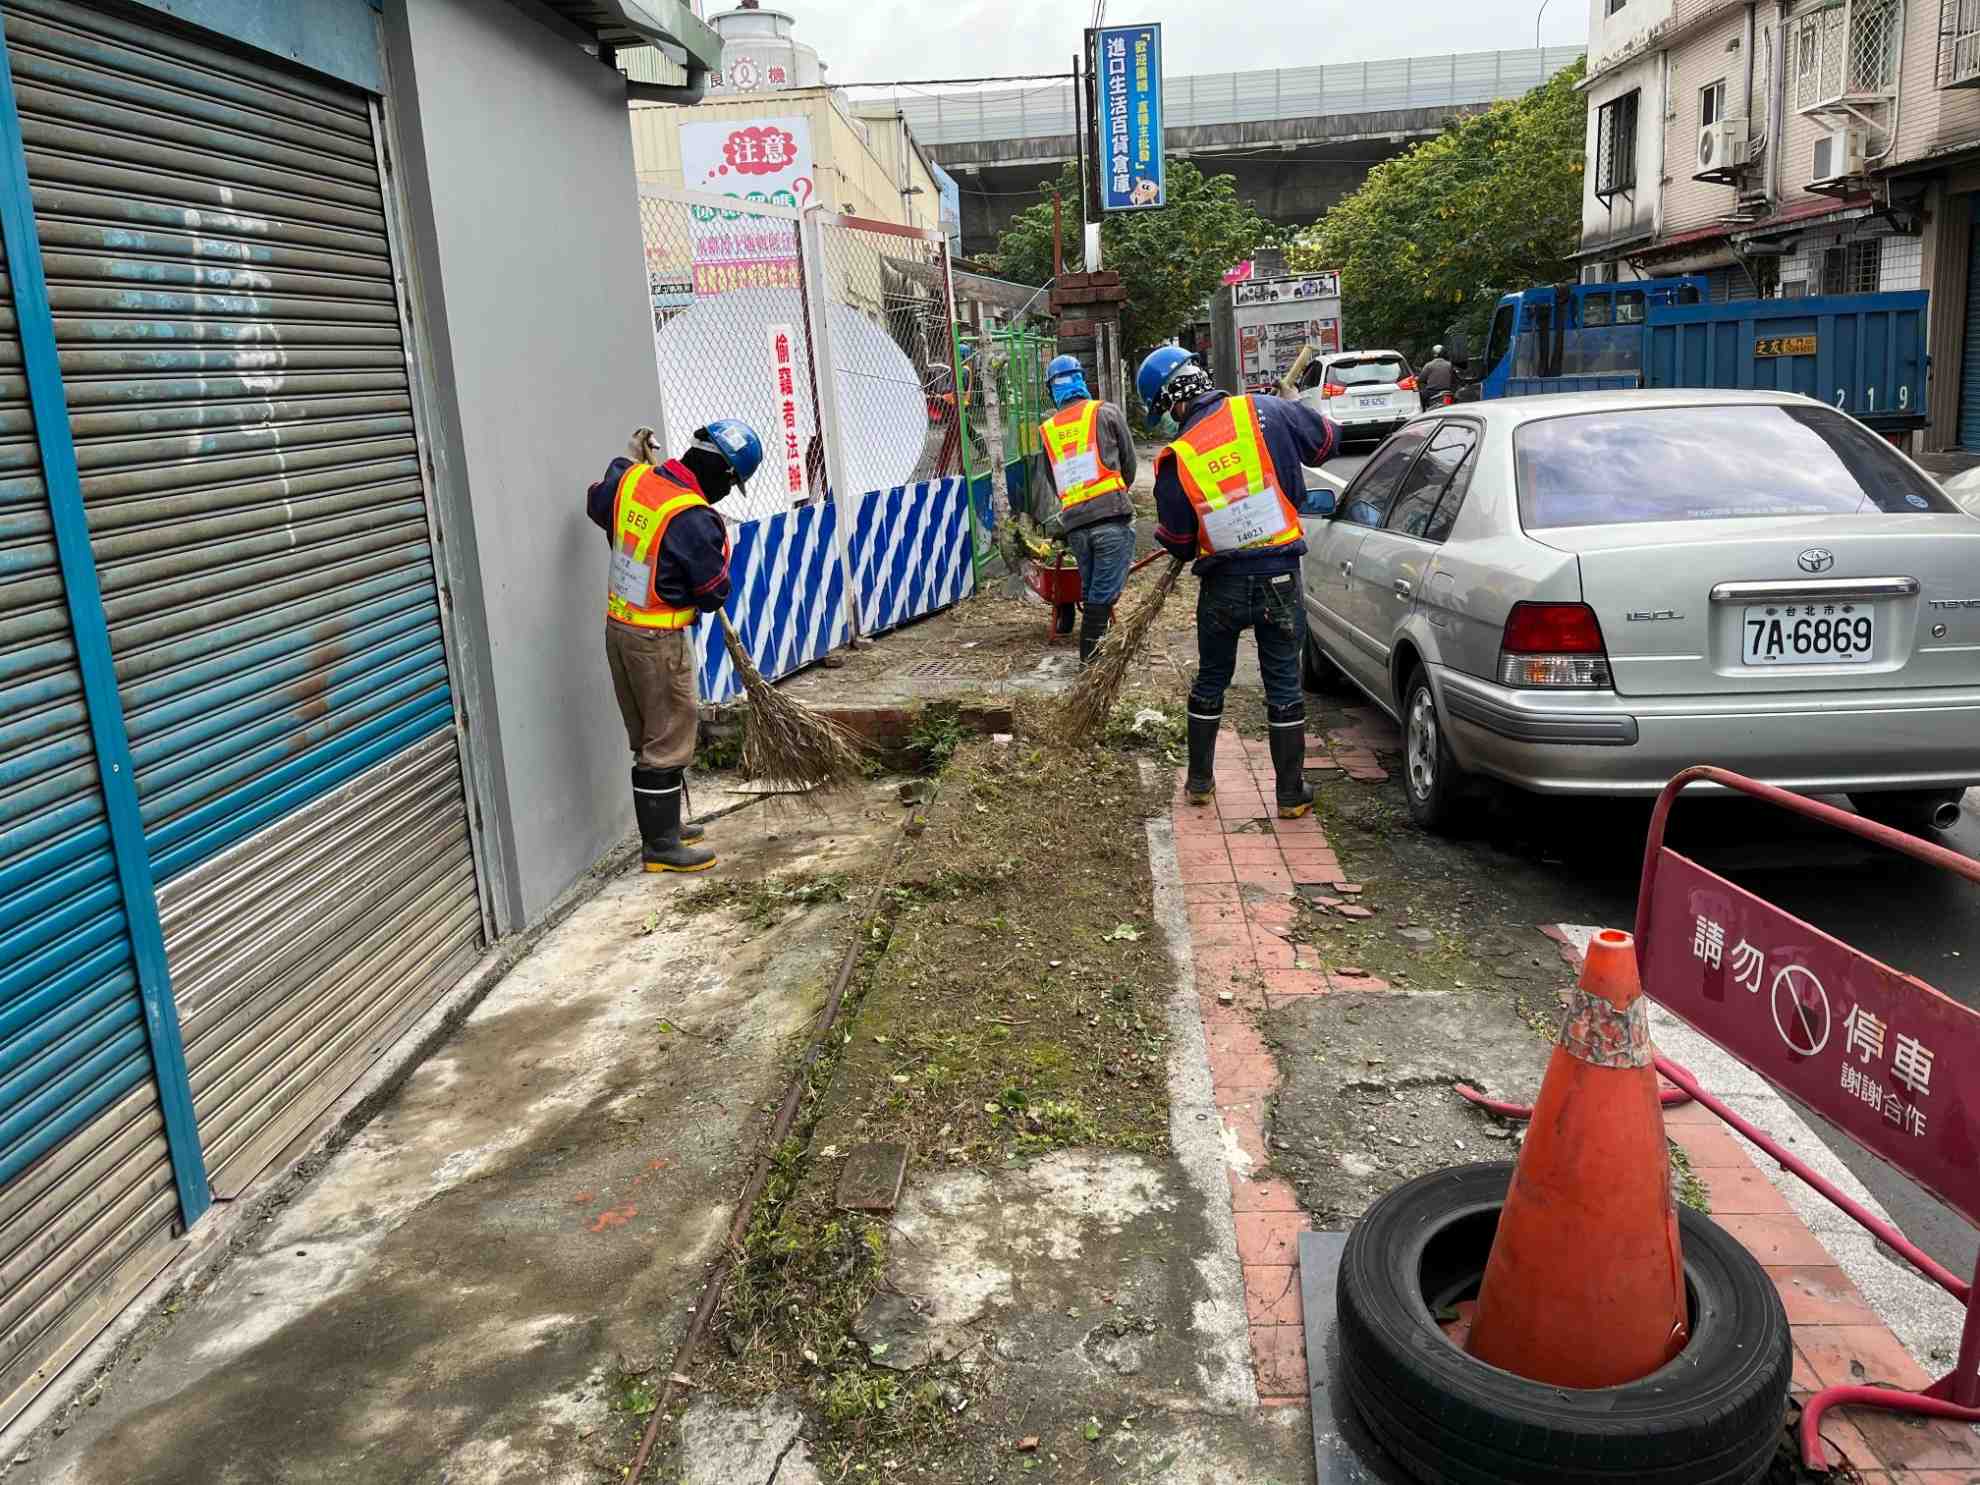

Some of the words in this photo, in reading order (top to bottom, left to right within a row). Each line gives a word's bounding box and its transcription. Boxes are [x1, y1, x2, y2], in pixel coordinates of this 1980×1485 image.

[1106, 36, 1131, 193] 進口生活百貨倉庫
[733, 134, 791, 165] 注意
[1058, 427, 1080, 441] BES
[1207, 451, 1242, 475] BES
[627, 511, 648, 530] BES
[1784, 604, 1836, 617] 台北市
[1691, 915, 1766, 994] 請勿
[1842, 1003, 1937, 1097] 停車
[1839, 1061, 1928, 1137] 謝謝合作
